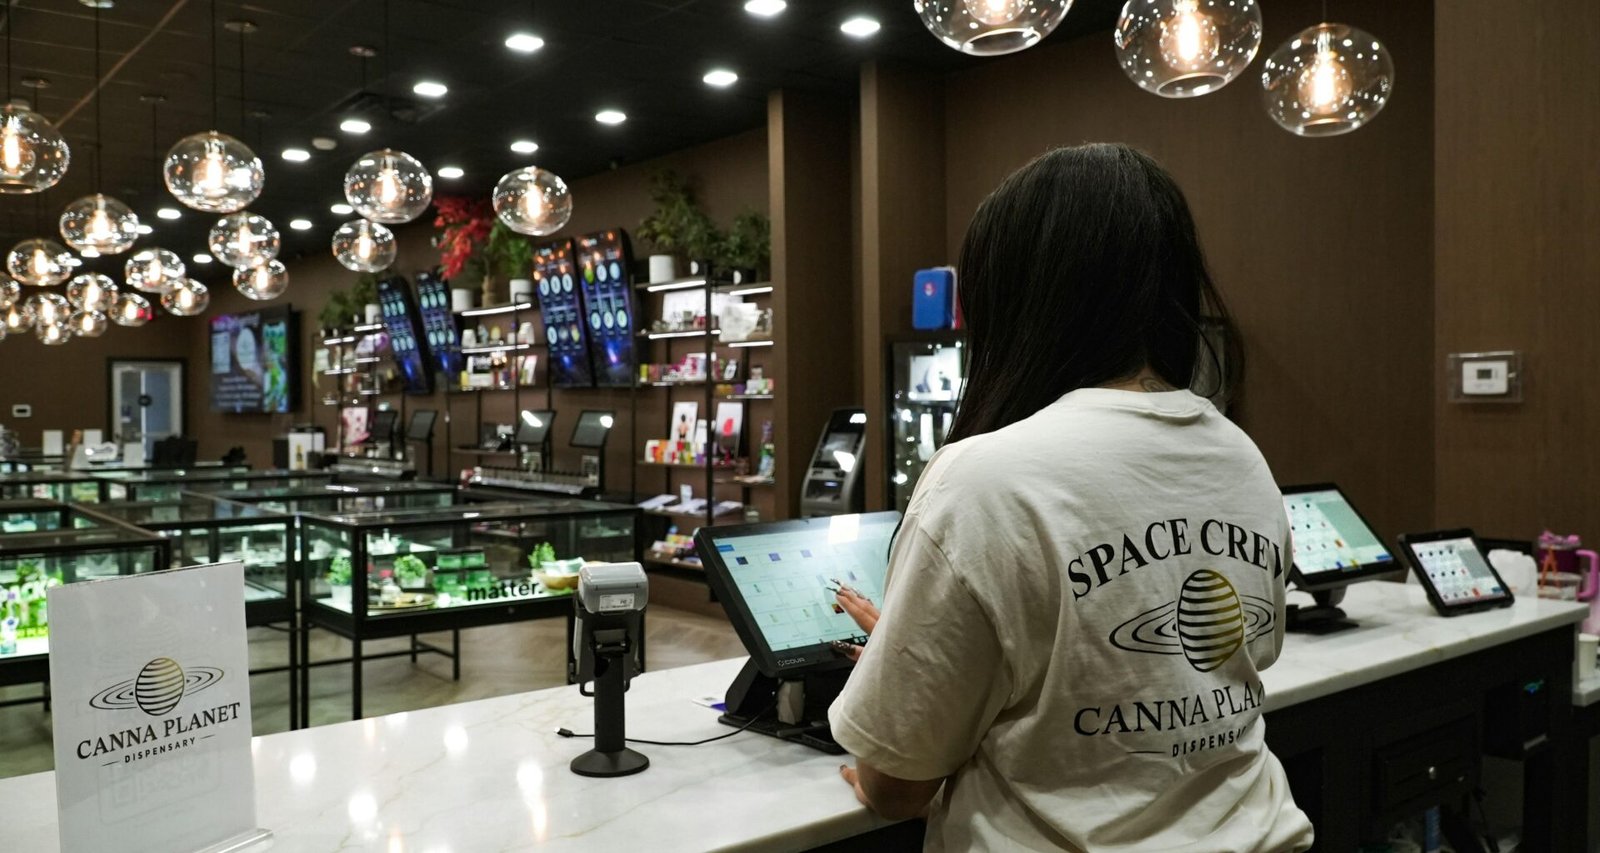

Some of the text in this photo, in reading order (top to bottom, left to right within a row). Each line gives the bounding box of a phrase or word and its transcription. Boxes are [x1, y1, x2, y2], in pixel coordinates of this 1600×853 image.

[1067, 518, 1192, 601] SPACE
[467, 580, 544, 601] matter.
[77, 702, 241, 760] CANNA PLANET
[1073, 694, 1209, 736] CANNA
[124, 737, 197, 763] DISPENSARY
